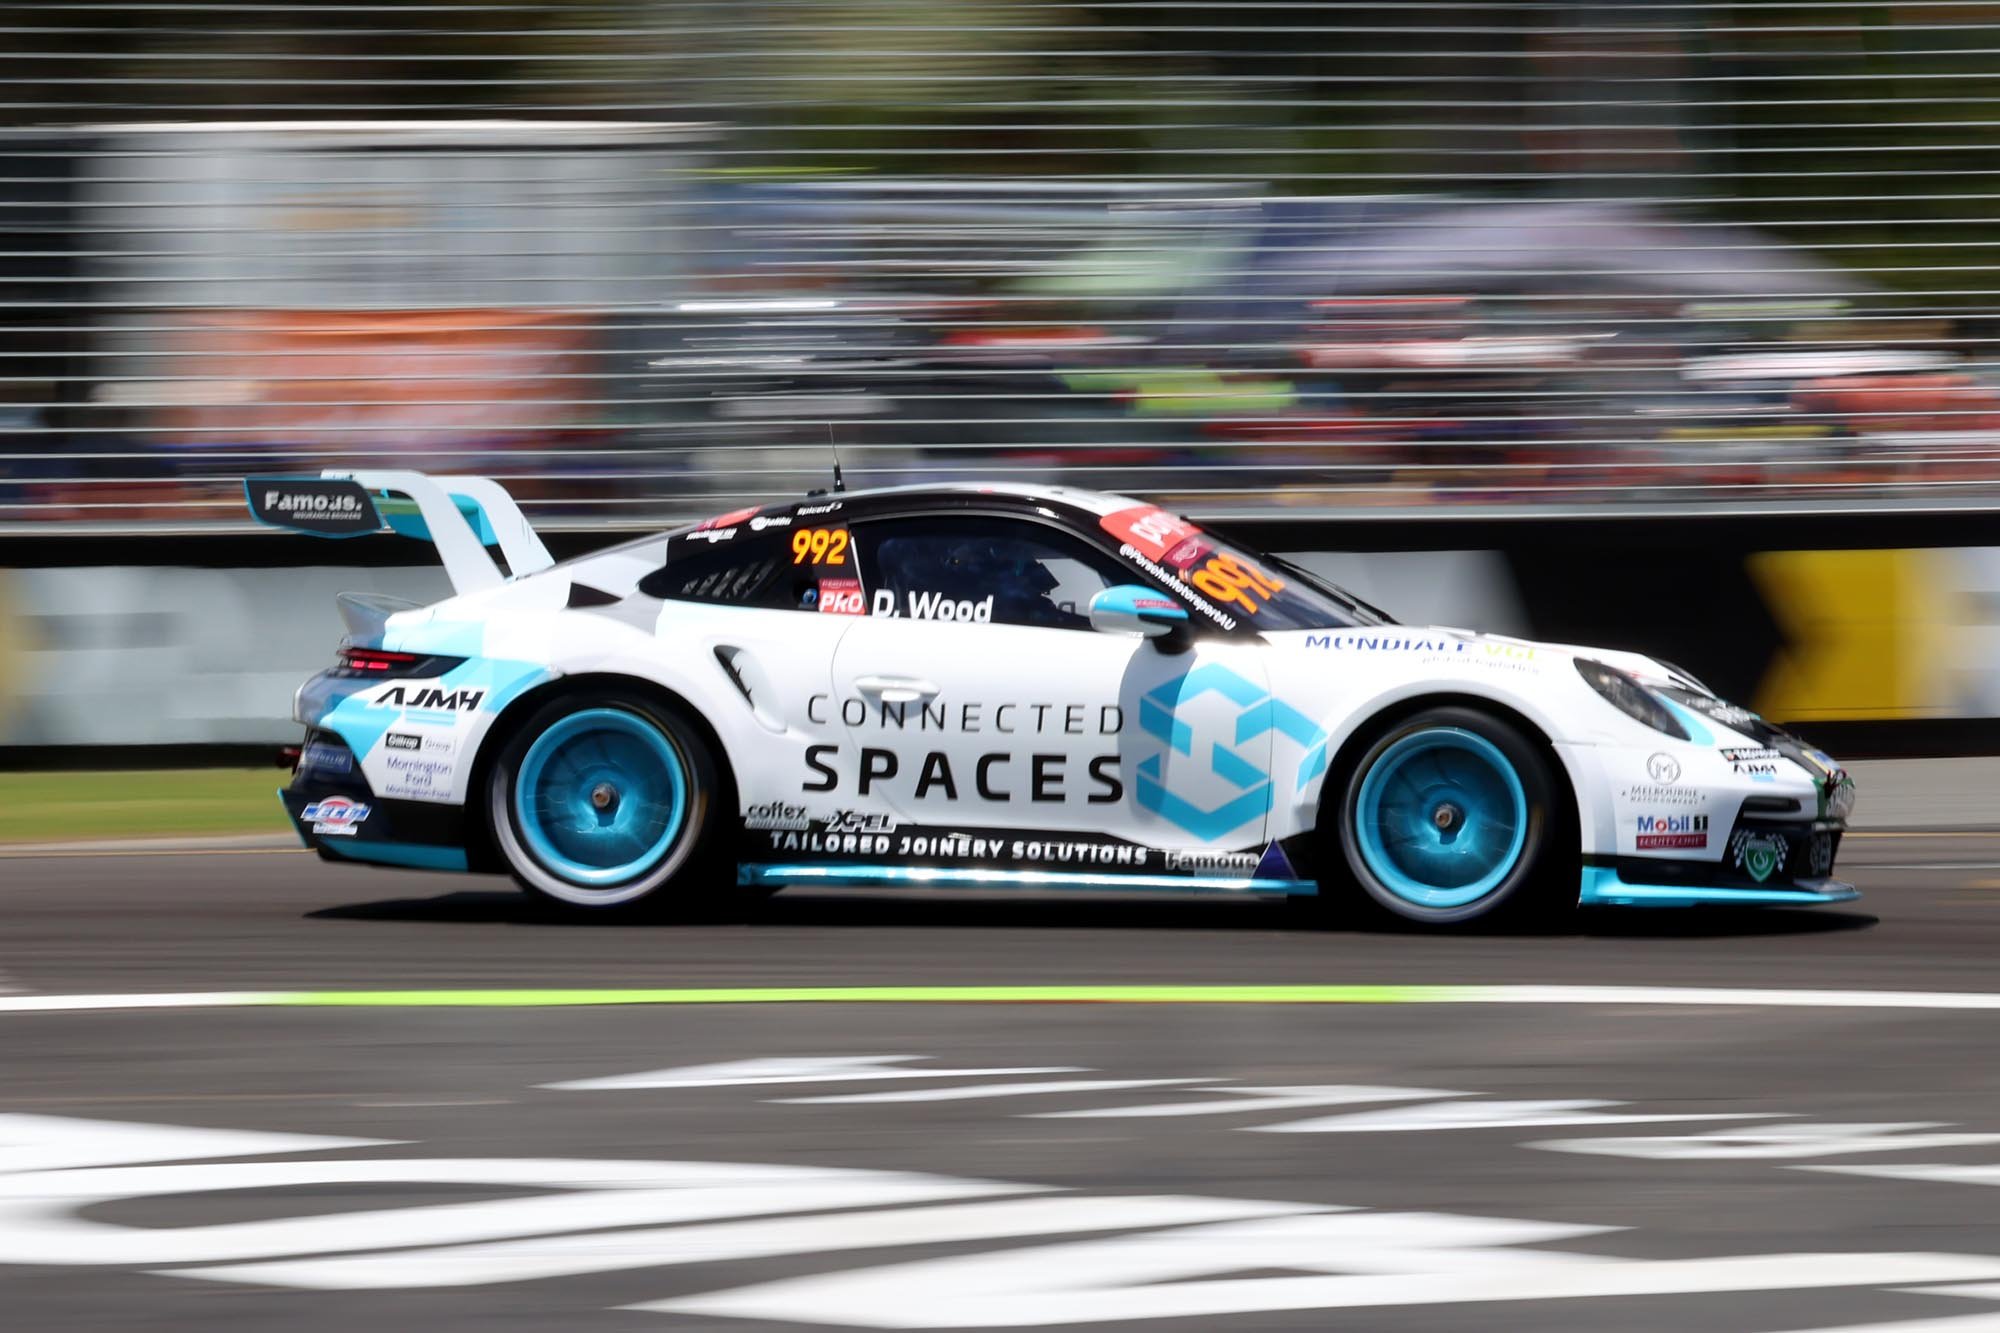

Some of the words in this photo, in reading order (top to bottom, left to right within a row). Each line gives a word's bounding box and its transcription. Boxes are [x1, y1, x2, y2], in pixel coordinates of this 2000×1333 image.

[792, 528, 848, 565] 992
[1192, 551, 1287, 614] 992
[872, 589, 899, 618] D.
[908, 591, 994, 623] Wood
[375, 687, 484, 711] AJMH
[807, 694, 1124, 735] CONNECTED
[801, 744, 1124, 805] SPACES
[1631, 785, 1697, 798] MELBOURNE
[826, 810, 897, 833] XPEL
[1637, 815, 1690, 832] Mobil
[770, 831, 891, 854] TAILORED
[898, 836, 1004, 858] JOINERY
[1012, 841, 1148, 865] SOLUTIONS
